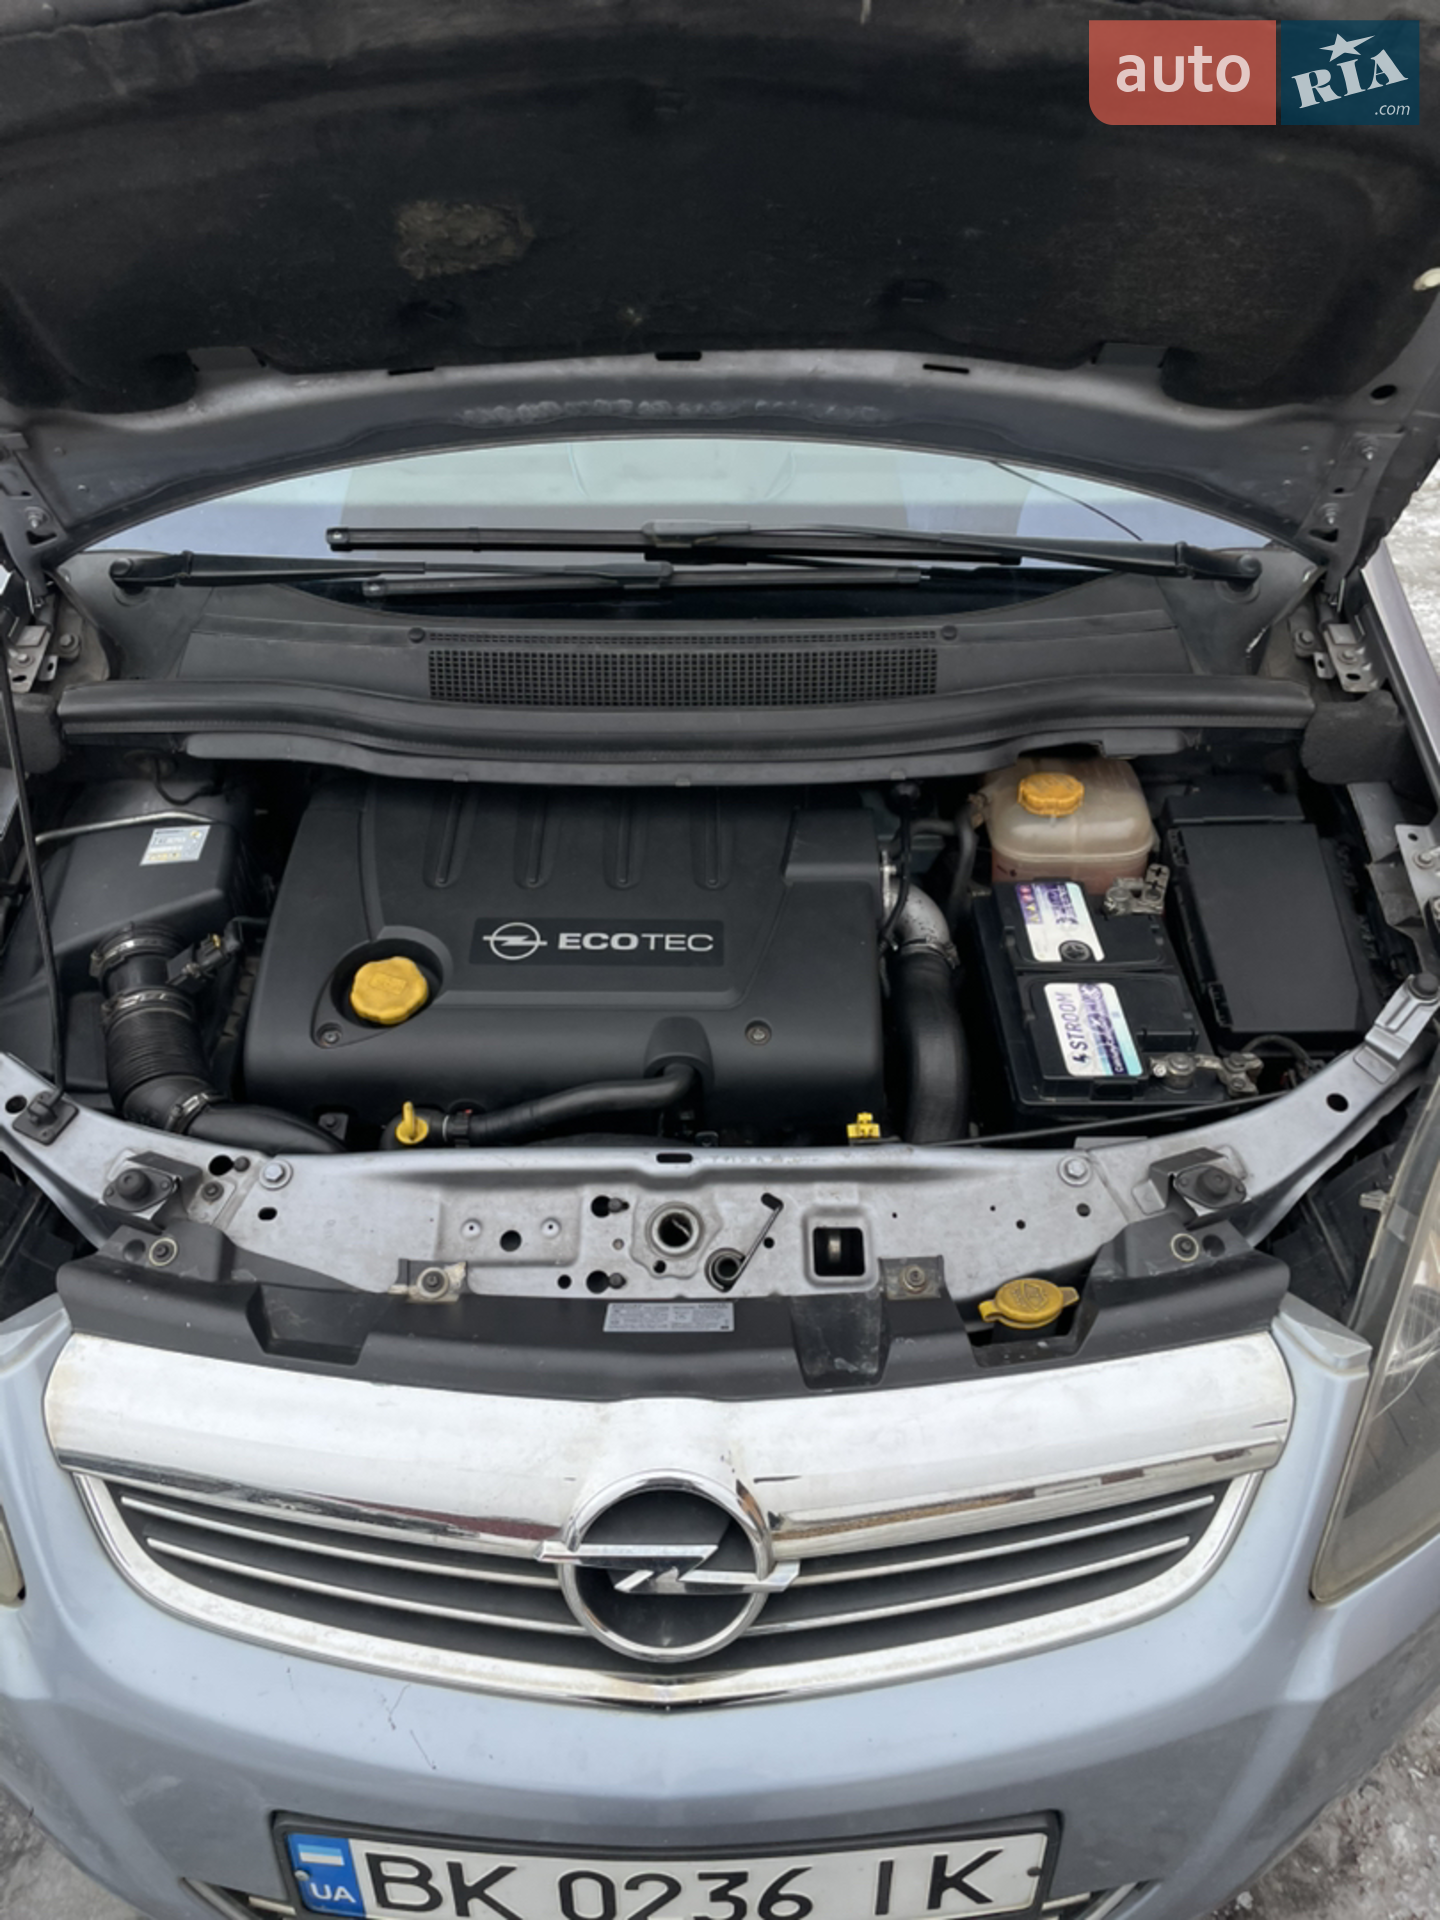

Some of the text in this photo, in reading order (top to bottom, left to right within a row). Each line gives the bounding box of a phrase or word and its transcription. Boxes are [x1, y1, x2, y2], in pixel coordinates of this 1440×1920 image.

[558, 932, 714, 952] ECOTEC
[1055, 991, 1088, 1051] STROOM
[310, 1882, 357, 1904] UA
[365, 1848, 1004, 1920] BK 0236 IK
